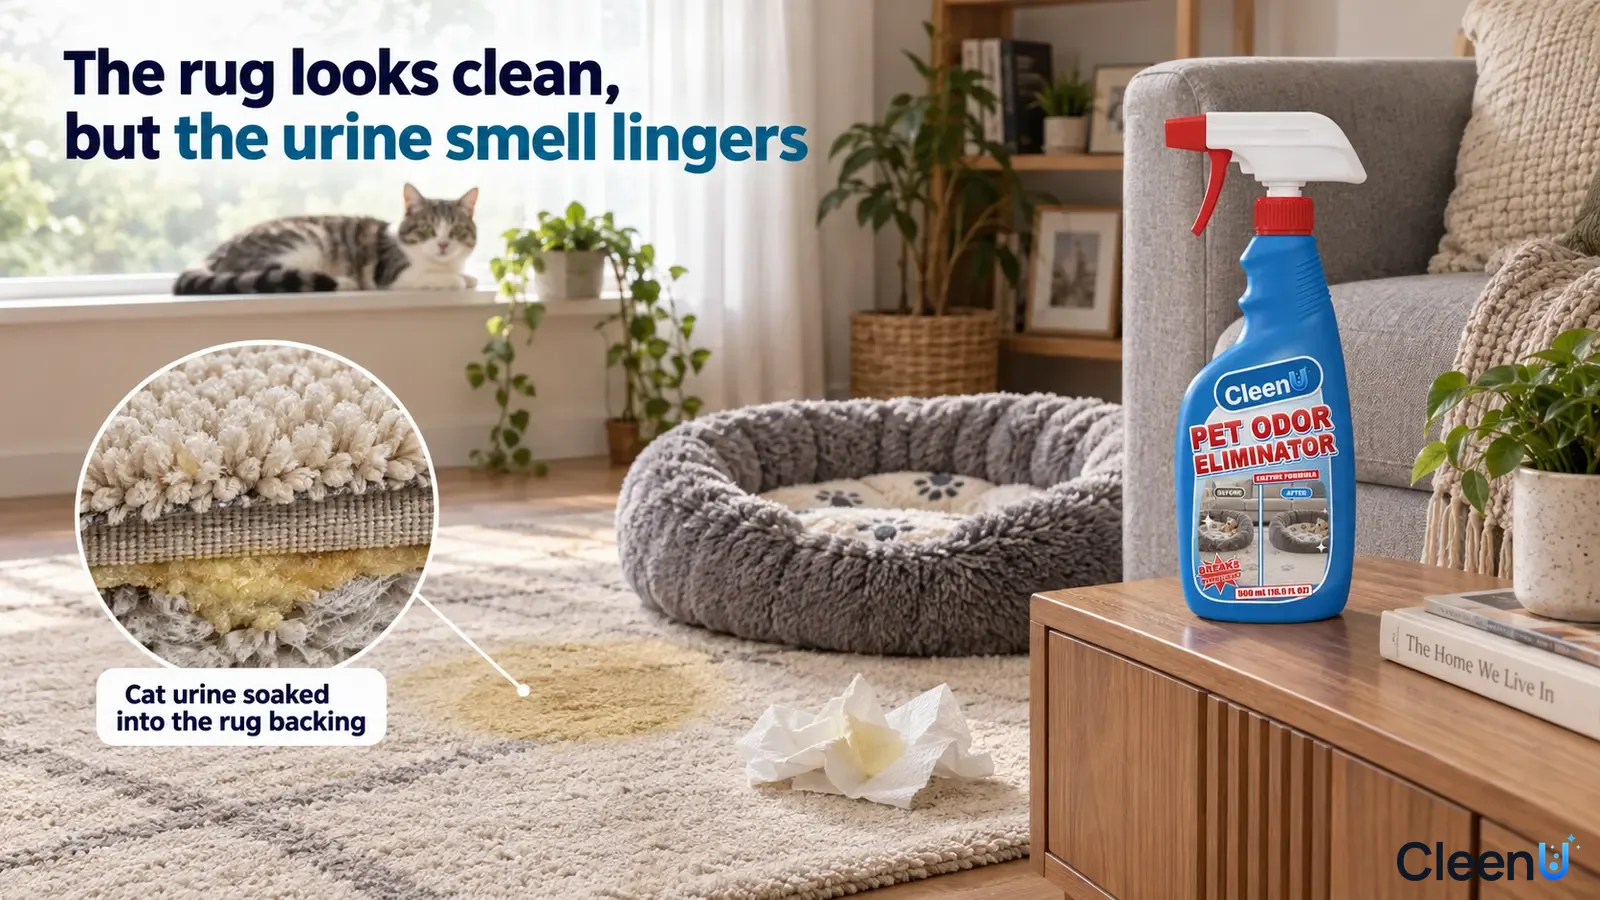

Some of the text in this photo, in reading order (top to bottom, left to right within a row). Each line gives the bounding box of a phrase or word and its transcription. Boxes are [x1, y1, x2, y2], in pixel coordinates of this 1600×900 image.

[1224, 367, 1310, 406] CleenU
[1190, 405, 1333, 450] PET ODOR
[1194, 433, 1337, 475] ELIMINATOR
[1406, 633, 1431, 658] The
[1434, 643, 1474, 674] Home
[1478, 659, 1500, 684] We
[1504, 668, 1535, 696] Live
[1539, 681, 1555, 704] In
